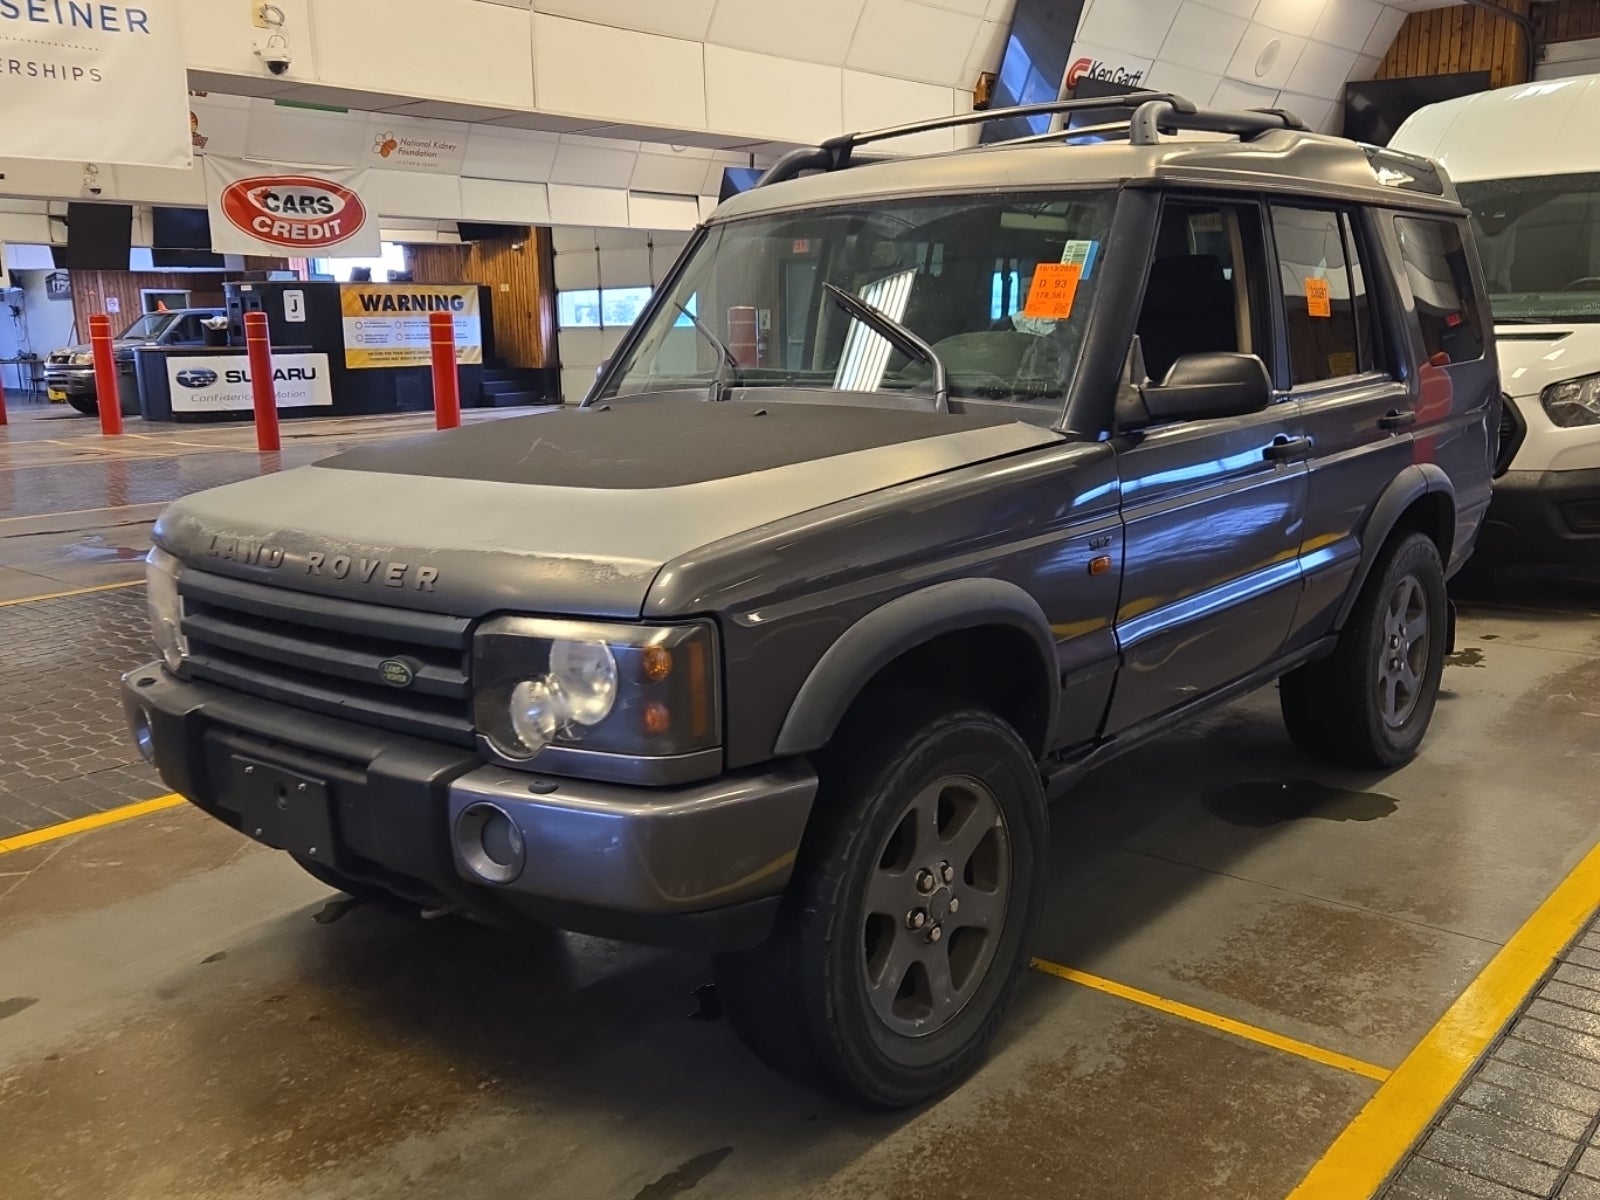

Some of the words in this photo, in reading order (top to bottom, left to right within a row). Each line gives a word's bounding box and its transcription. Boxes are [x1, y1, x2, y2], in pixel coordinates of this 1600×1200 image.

[0, 0, 151, 34] SEINER
[398, 148, 438, 158] Foundation
[399, 138, 431, 148] National
[433, 141, 457, 152] Kidney
[262, 193, 334, 215] CARS
[252, 216, 342, 240] CREDIT
[1054, 279, 1068, 289] 93
[290, 298, 298, 313] J
[359, 294, 465, 312] WARNING
[225, 367, 317, 383] SUARU
[191, 392, 253, 402] Confidenc
[206, 535, 285, 569] LAND
[304, 551, 439, 593] ROVER
